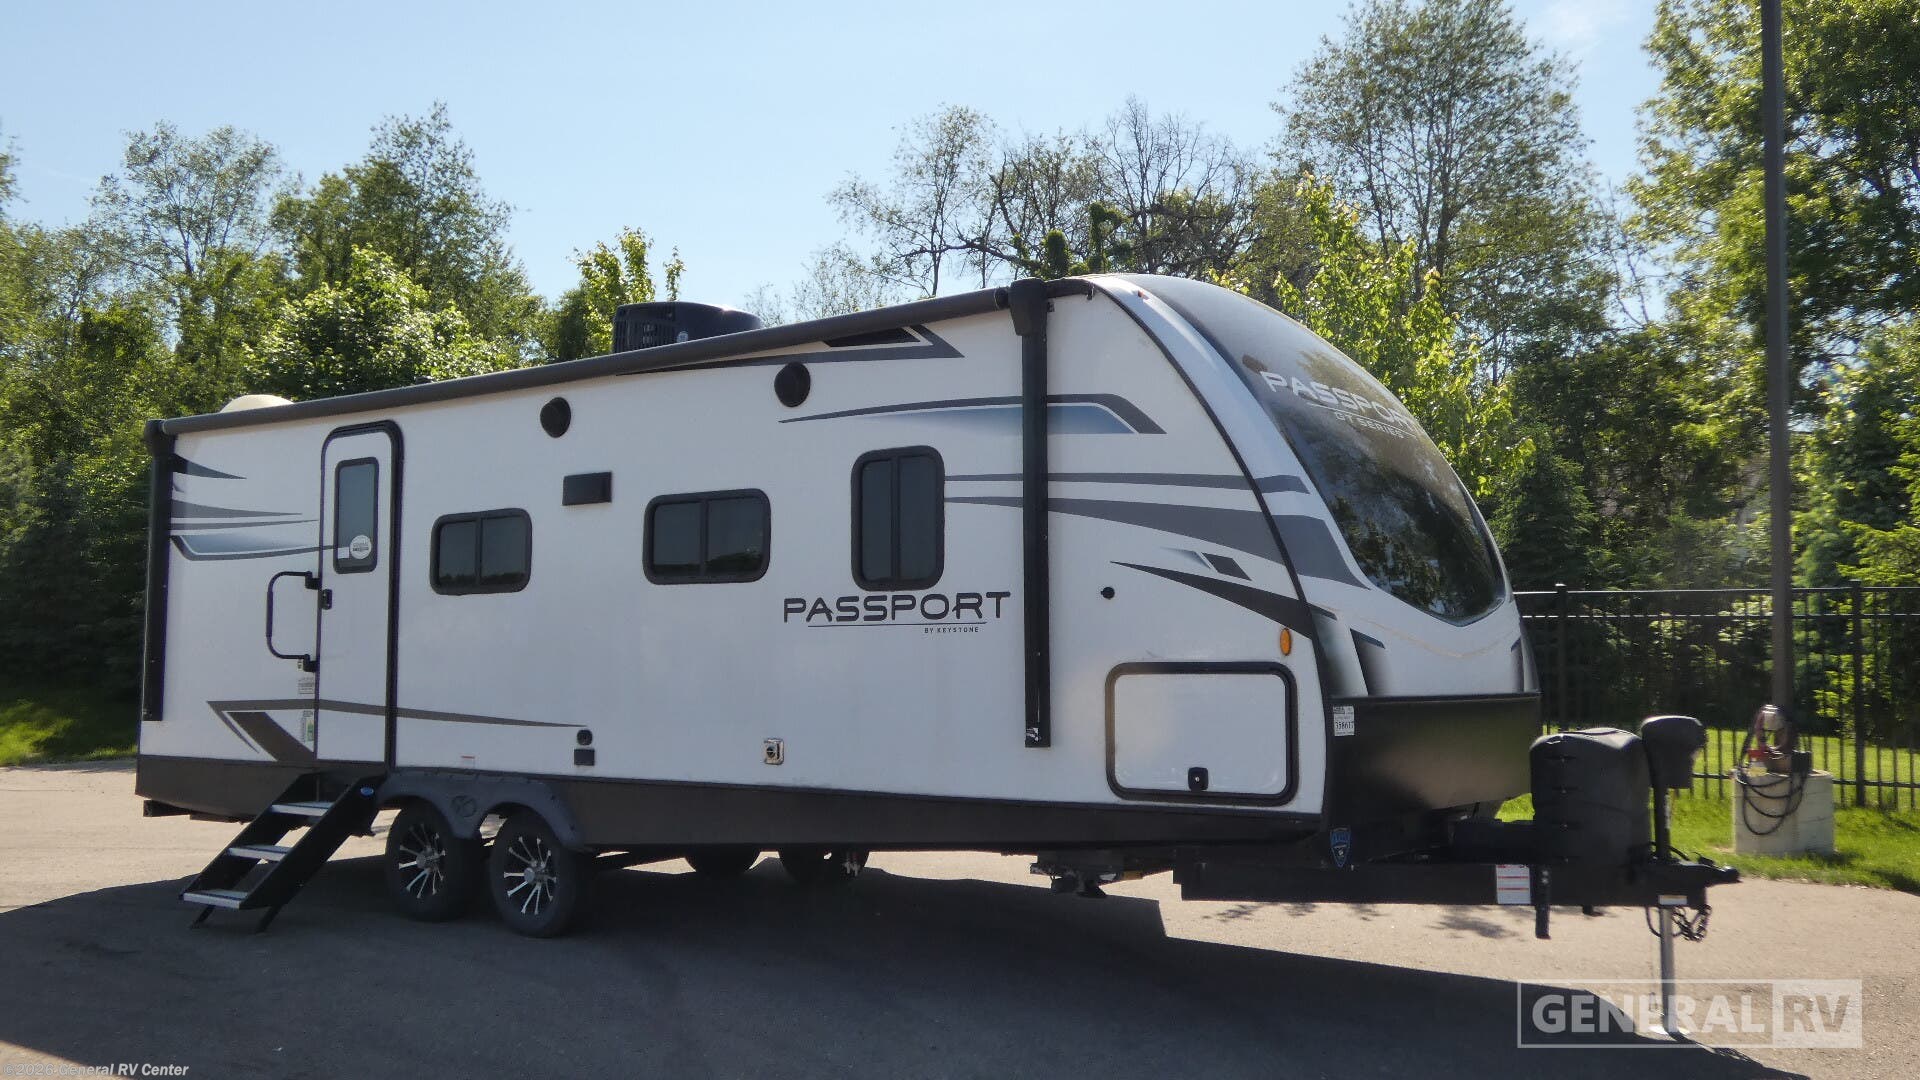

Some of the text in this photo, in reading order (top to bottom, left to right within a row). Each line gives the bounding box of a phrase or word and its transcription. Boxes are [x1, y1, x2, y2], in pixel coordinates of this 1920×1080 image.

[1334, 411, 1404, 438] GT SERIES
[784, 591, 1011, 623] PASSPORT
